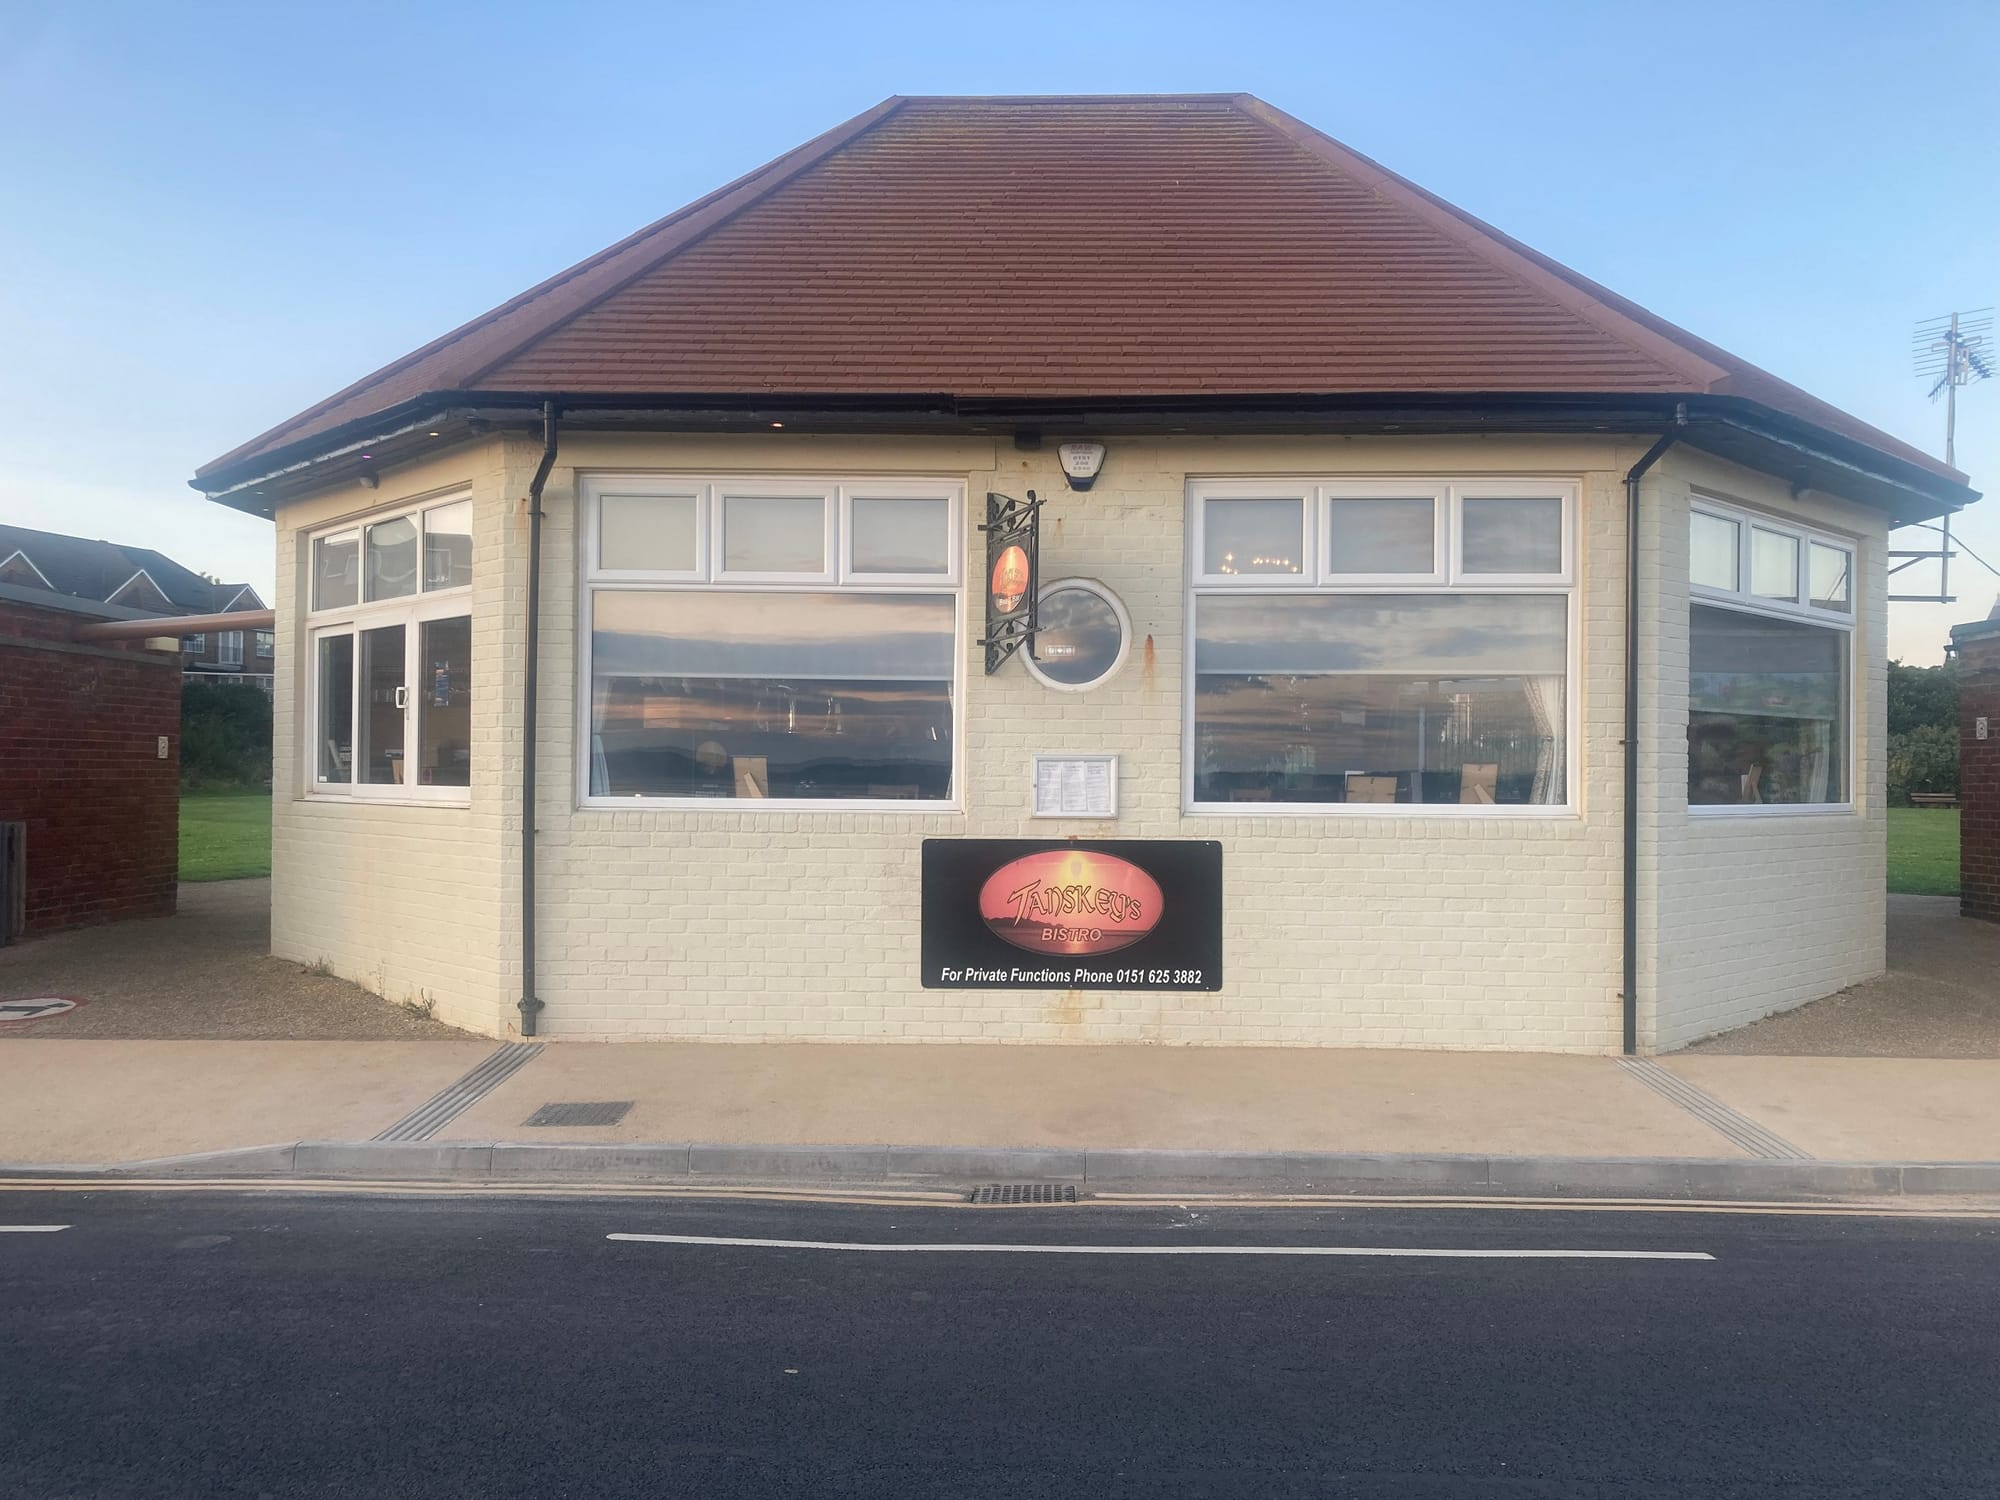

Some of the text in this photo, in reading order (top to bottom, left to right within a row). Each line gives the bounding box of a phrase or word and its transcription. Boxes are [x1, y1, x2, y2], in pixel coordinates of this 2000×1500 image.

[1041, 928, 1103, 942] BISTRO
[941, 967, 1202, 984] For Private Functions Phone 0151 625 3882
